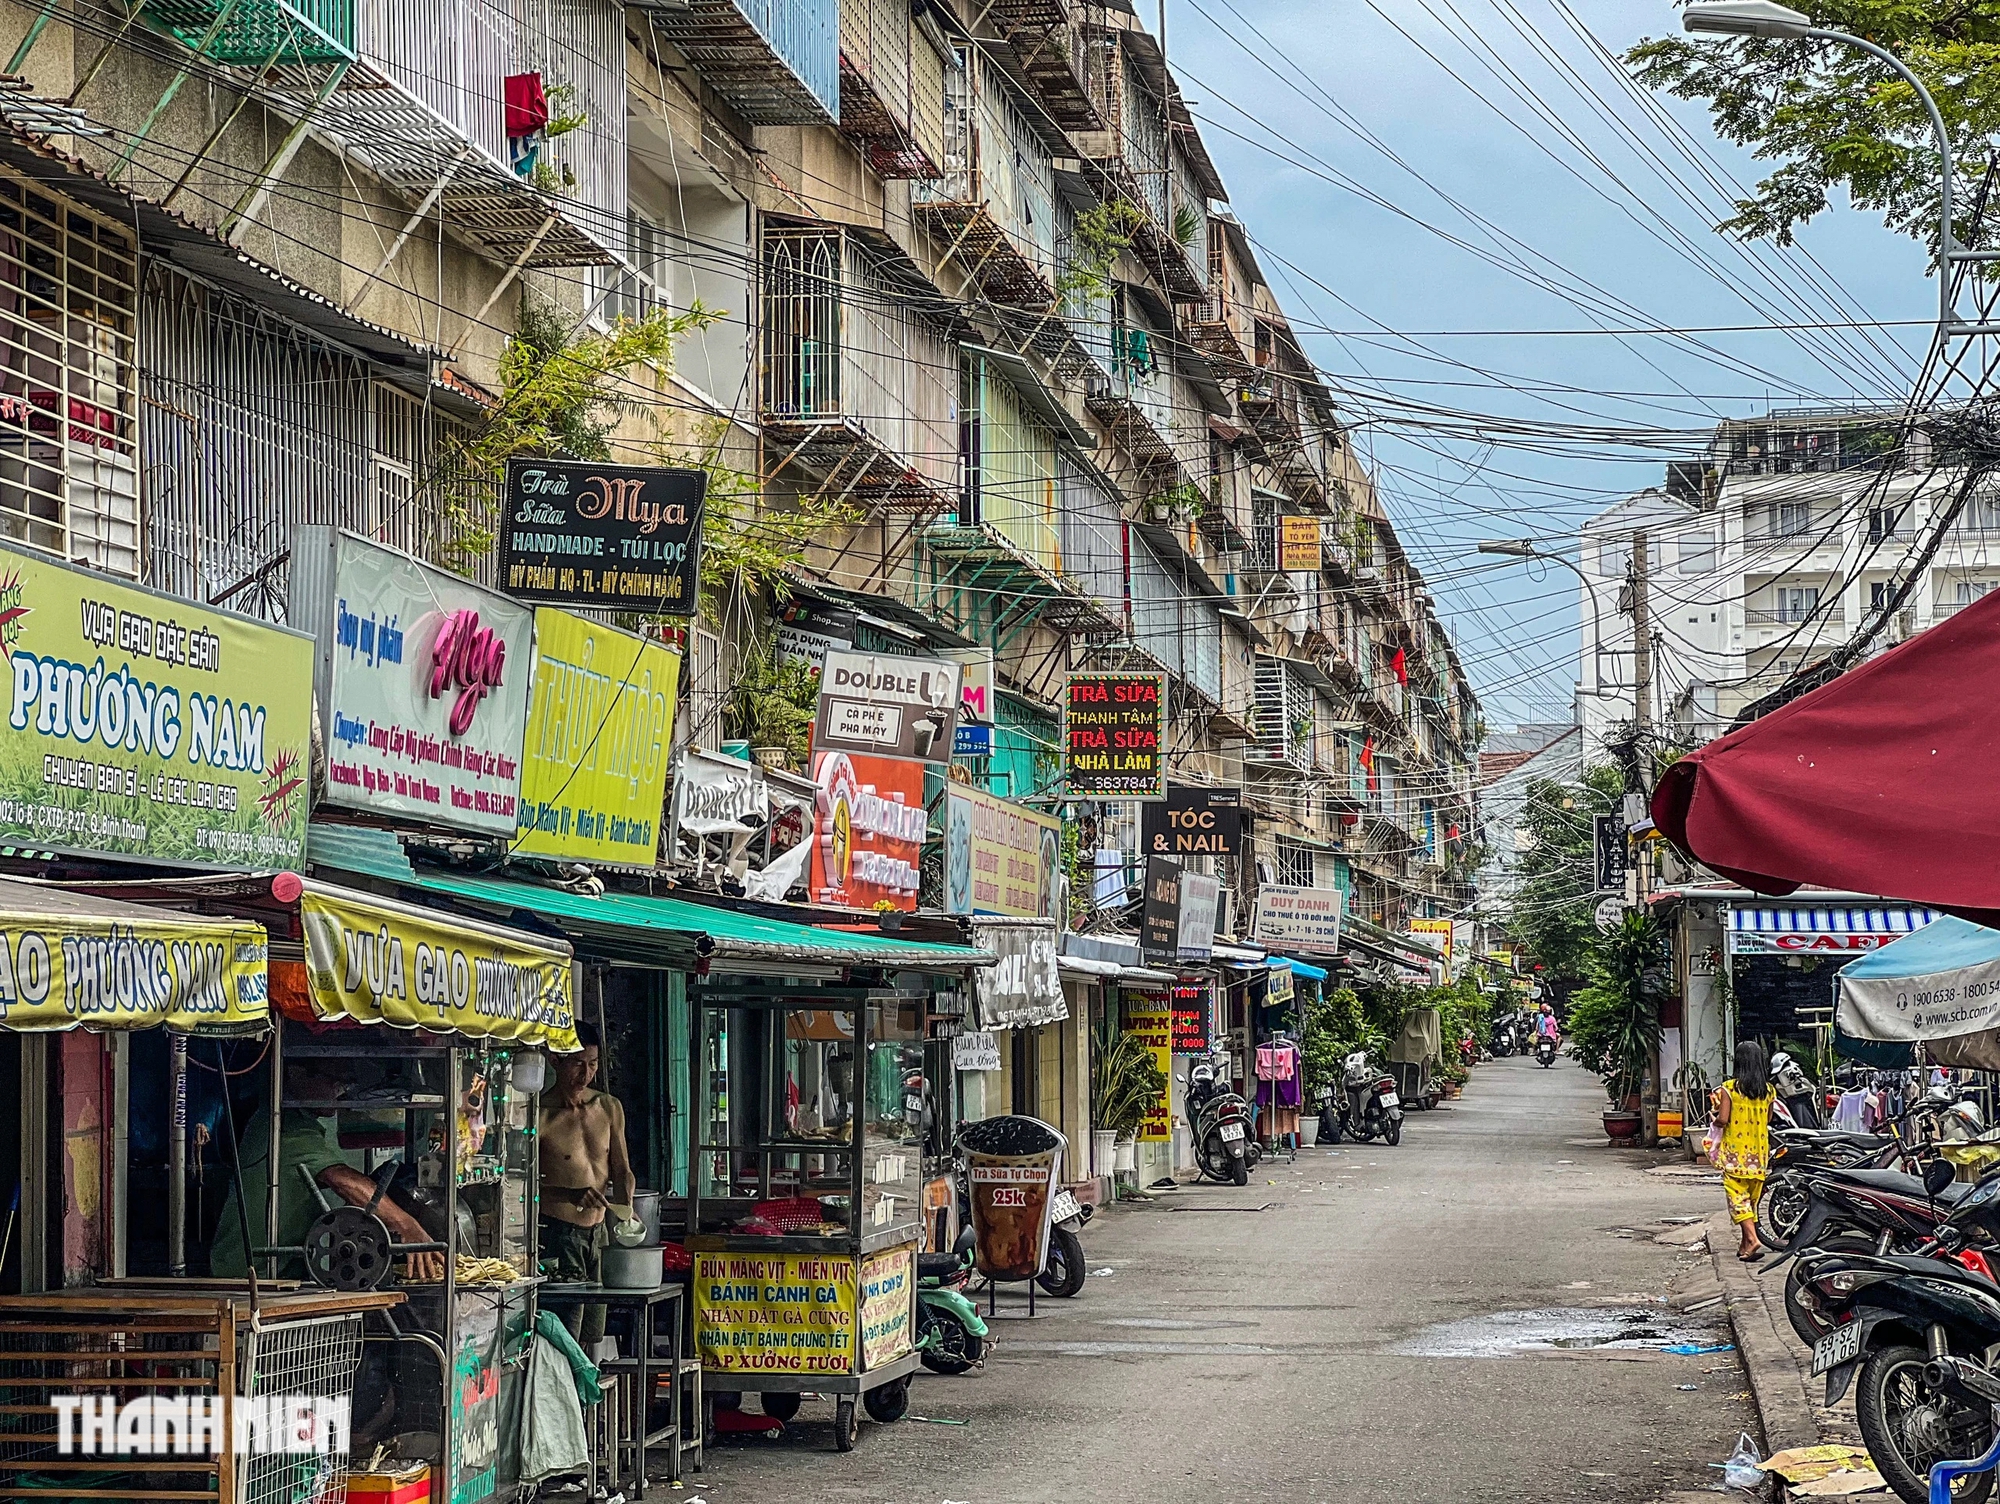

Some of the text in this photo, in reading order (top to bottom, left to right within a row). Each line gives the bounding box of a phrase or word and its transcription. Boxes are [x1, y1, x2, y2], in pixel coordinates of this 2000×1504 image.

[520, 469, 570, 496] Trà
[515, 498, 567, 526] Sữa
[575, 475, 689, 535] Mya
[512, 531, 688, 566] HANDMADE TÚI LỌC
[508, 557, 526, 589] MỸ
[526, 554, 556, 591] PHẨM
[558, 566, 576, 594] HQ
[601, 564, 620, 596] MỸ
[618, 566, 653, 598] CHÍNH
[81, 597, 221, 673] VỰA GẠO ĐẶC SẢN
[337, 597, 359, 661] Shop
[779, 629, 832, 648] GIA DỤNG
[834, 667, 918, 695] DOUBLE
[1070, 680, 1158, 703] TRÀ SỮA
[10, 649, 267, 775] PHƯƠNG NAM
[845, 706, 886, 722] CÀ PHÊ
[1070, 707, 1154, 725] THANH TÂM
[839, 721, 889, 738] PHA MÁY
[1070, 726, 1158, 748] TRÀ SỮA
[368, 719, 390, 758] Cung
[389, 723, 405, 761] Cấp
[440, 740, 464, 770] Chính
[482, 749, 497, 777] Các
[1074, 749, 1152, 771] NHÀ LÀM
[42, 753, 238, 816] CHUYÊN BÁN SỈ LẺ CÁC LOẠI GẠO
[102, 813, 120, 837] Bình
[121, 815, 147, 845] Thạnh
[518, 797, 536, 829] Bún
[576, 805, 596, 840] Miến
[1167, 805, 1217, 829] TÓC
[1153, 833, 1231, 852] & NAIL
[1263, 910, 1277, 918] CHO
[1277, 911, 1294, 920] THUÊ
[1271, 896, 1331, 912] DUY DANH
[61, 921, 228, 1014] PHƯƠNG NAM
[344, 923, 407, 1010] VỰA
[414, 941, 470, 1018] GẠO
[474, 947, 520, 1021] PHƯƠNG
[1913, 991, 1933, 1007] 1900
[1933, 988, 1956, 1004] 6538
[1963, 982, 1987, 1000] 1800
[1925, 1001, 1999, 1026] www.scb.com.vn
[955, 1054, 975, 1068] Cua
[973, 1167, 1047, 1183] Trà Sữa Tự Chọn
[992, 1187, 1026, 1207] 25k
[701, 1254, 850, 1285] BÚN MĂNG VỊT MIẾN VỊT
[710, 1280, 838, 1304] BÁNH CANH GÀ
[700, 1306, 745, 1325] NHẬN
[749, 1307, 779, 1328] ĐẶT
[782, 1306, 804, 1325] GÀ
[808, 1307, 850, 1326] CÚNG
[700, 1327, 850, 1350] NHẬN ĐẶT BÁNH CHƯNG TẾT
[1820, 1325, 1855, 1354] 59-S2
[701, 1349, 850, 1373] LẠP XƯỞNG TƯƠI
[1814, 1340, 1857, 1372] 111.06
